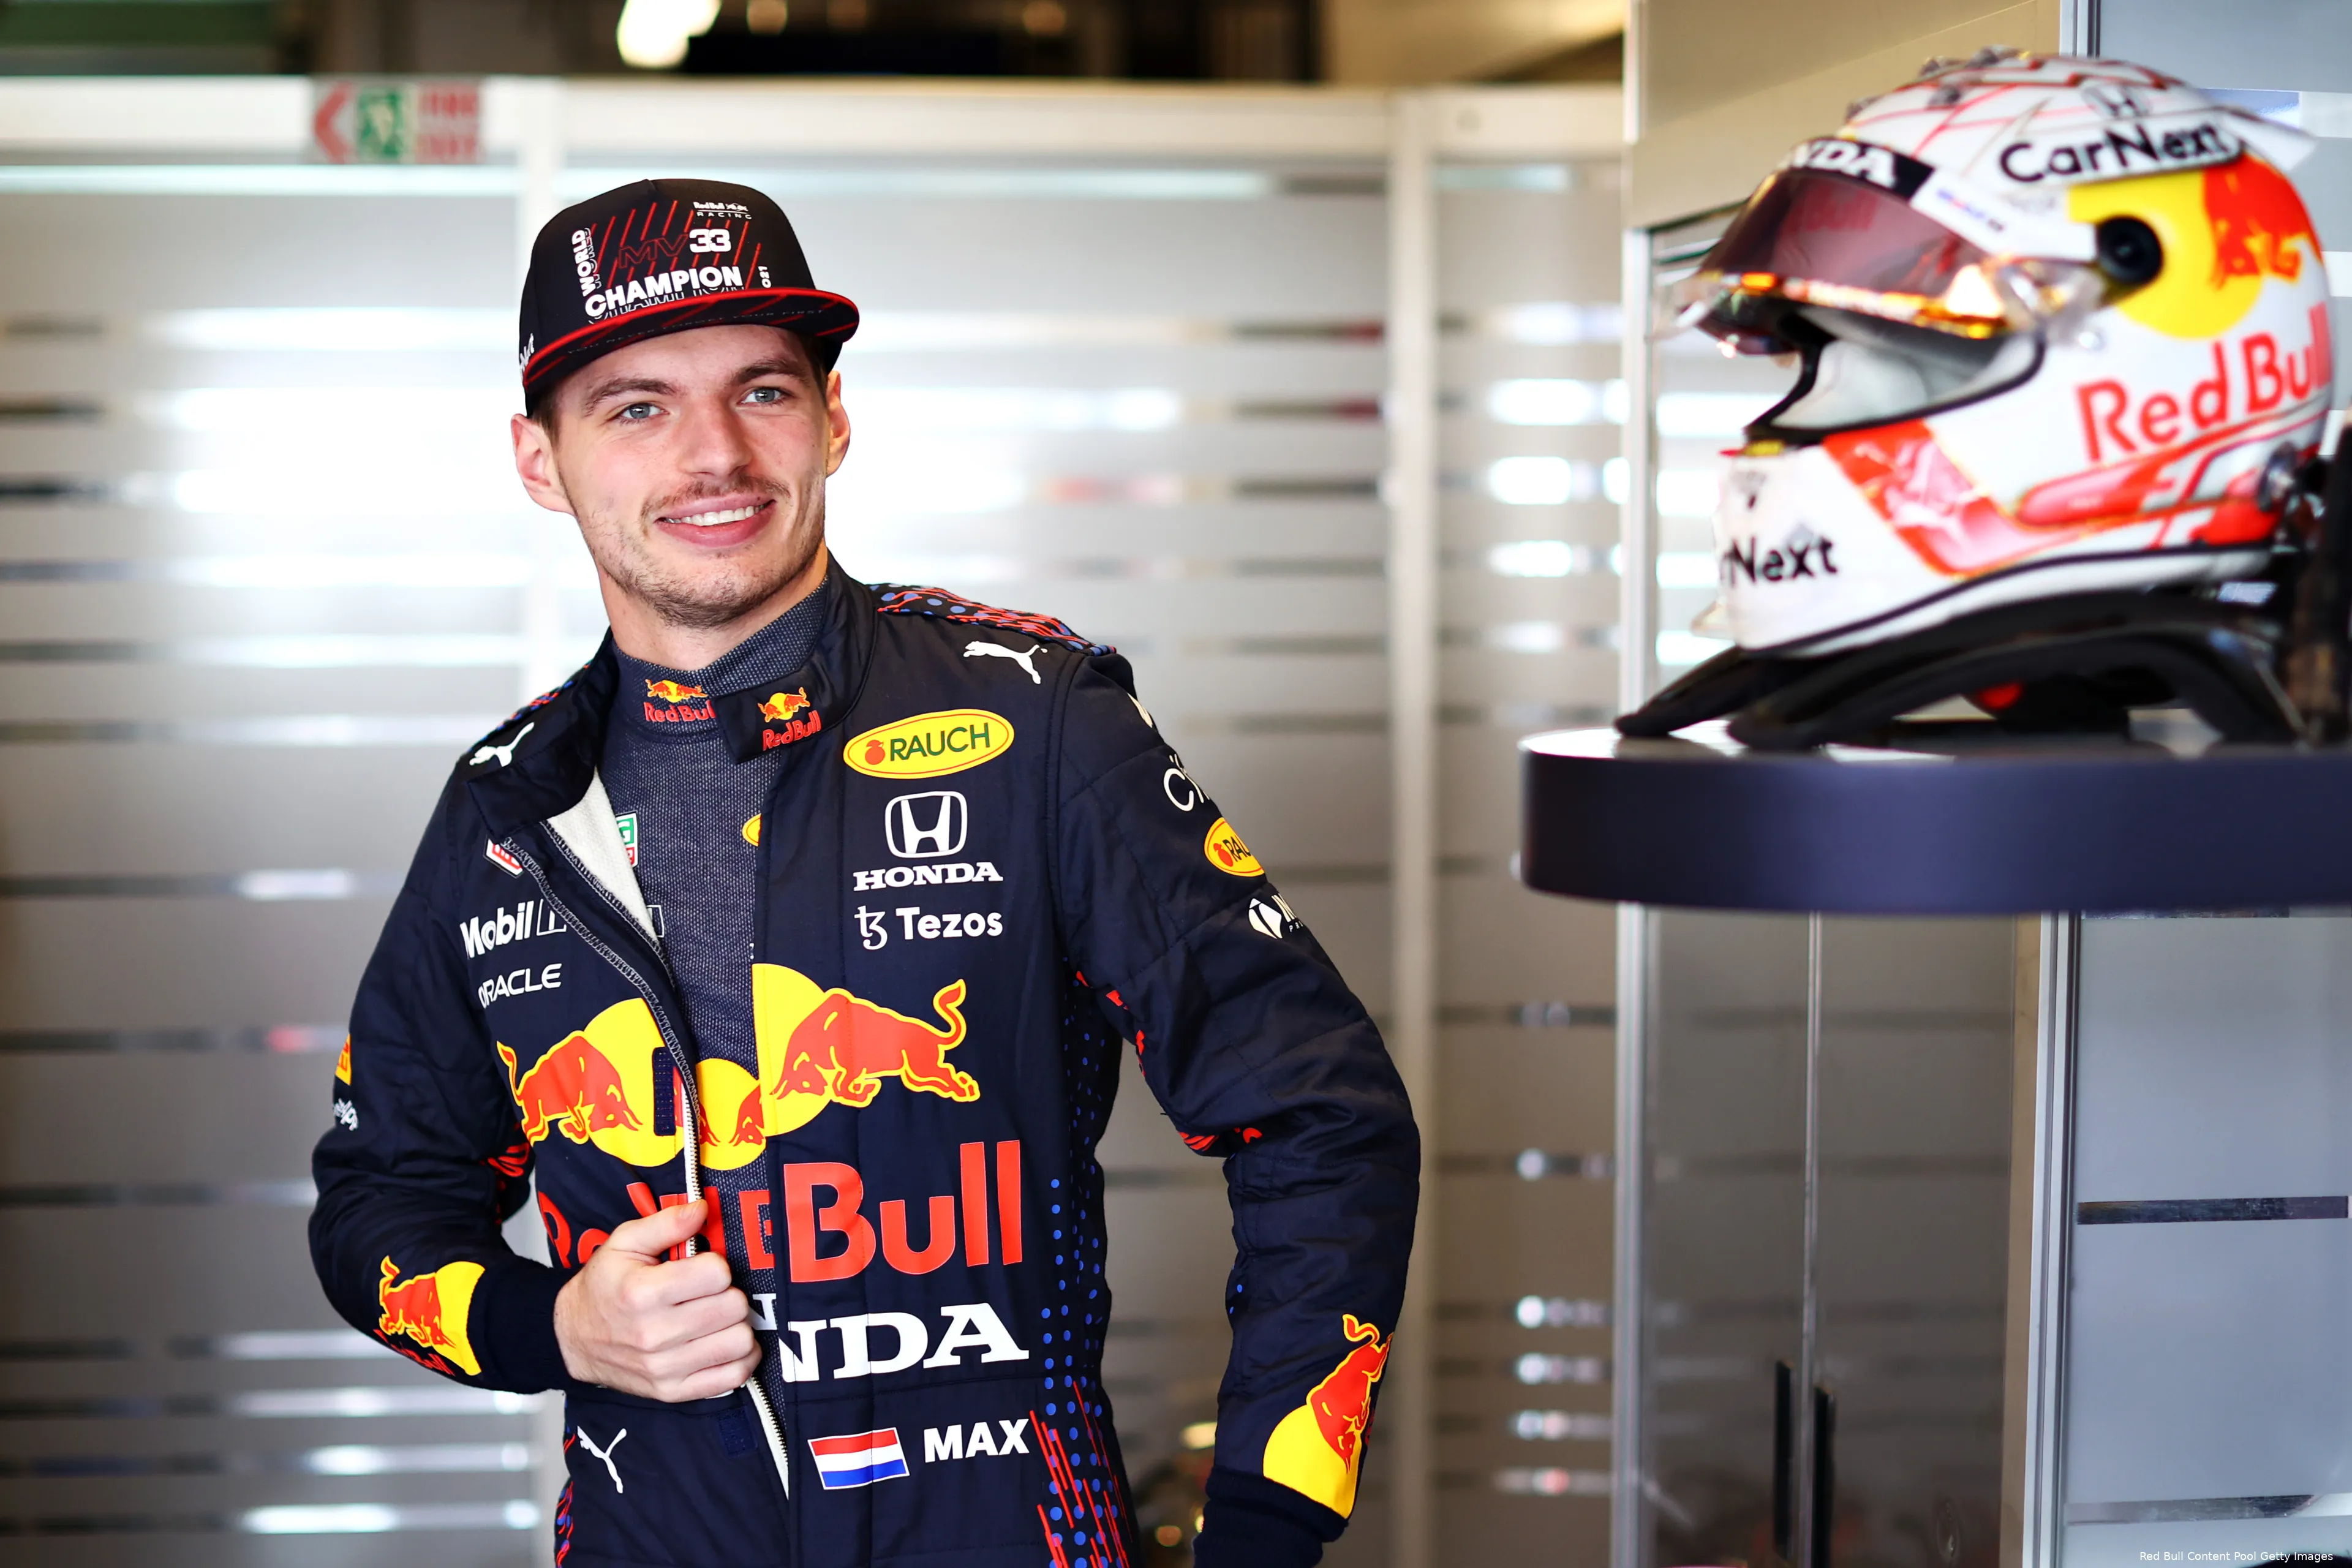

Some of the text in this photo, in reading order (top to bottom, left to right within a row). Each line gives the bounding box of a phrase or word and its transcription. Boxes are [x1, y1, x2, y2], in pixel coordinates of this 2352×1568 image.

[1999, 121, 2230, 183] CarNext
[696, 211, 752, 220] RACING
[571, 229, 597, 297] WORLD
[689, 228, 731, 253] 33
[585, 266, 744, 317] CHAMPION
[2076, 340, 2230, 462] Red
[643, 701, 679, 723] Red
[763, 710, 821, 751] Red Bull
[890, 723, 990, 762] RAUCH
[853, 862, 1004, 891] HONDA
[459, 900, 534, 960] Mobil
[895, 907, 1003, 940] Tezos
[478, 963, 562, 1009] ORACLE
[783, 1140, 1023, 1283] Bull
[924, 1418, 1030, 1463] MAX
